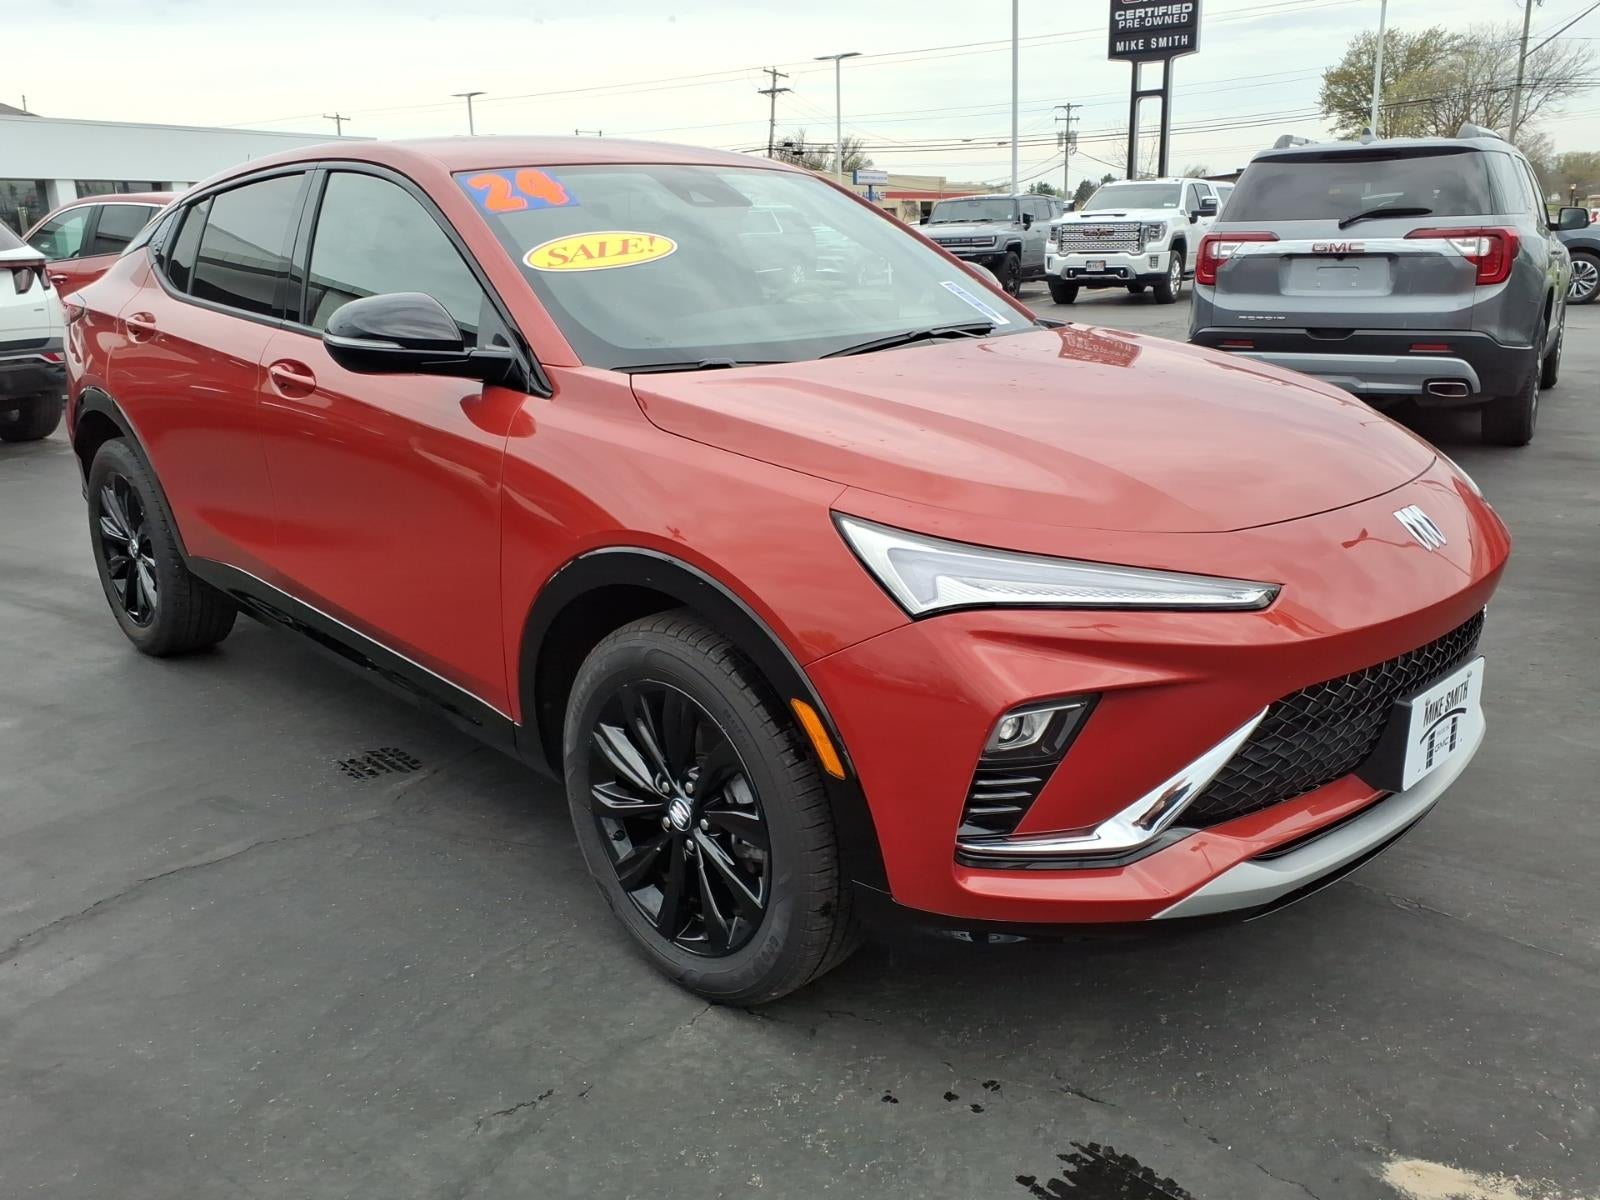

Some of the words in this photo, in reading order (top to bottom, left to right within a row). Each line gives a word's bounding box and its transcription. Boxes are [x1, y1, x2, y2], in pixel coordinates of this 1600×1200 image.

[1115, 3, 1193, 20] CERTIFIED
[1118, 13, 1188, 29] PRE-OWNED
[1116, 39, 1144, 52] MIKE
[1150, 35, 1188, 49] SMITH
[467, 168, 570, 212] 24
[547, 235, 657, 268] SALE!
[1312, 242, 1365, 253] GMC
[1423, 696, 1444, 728] MIKE
[1445, 680, 1469, 712] SMITH
